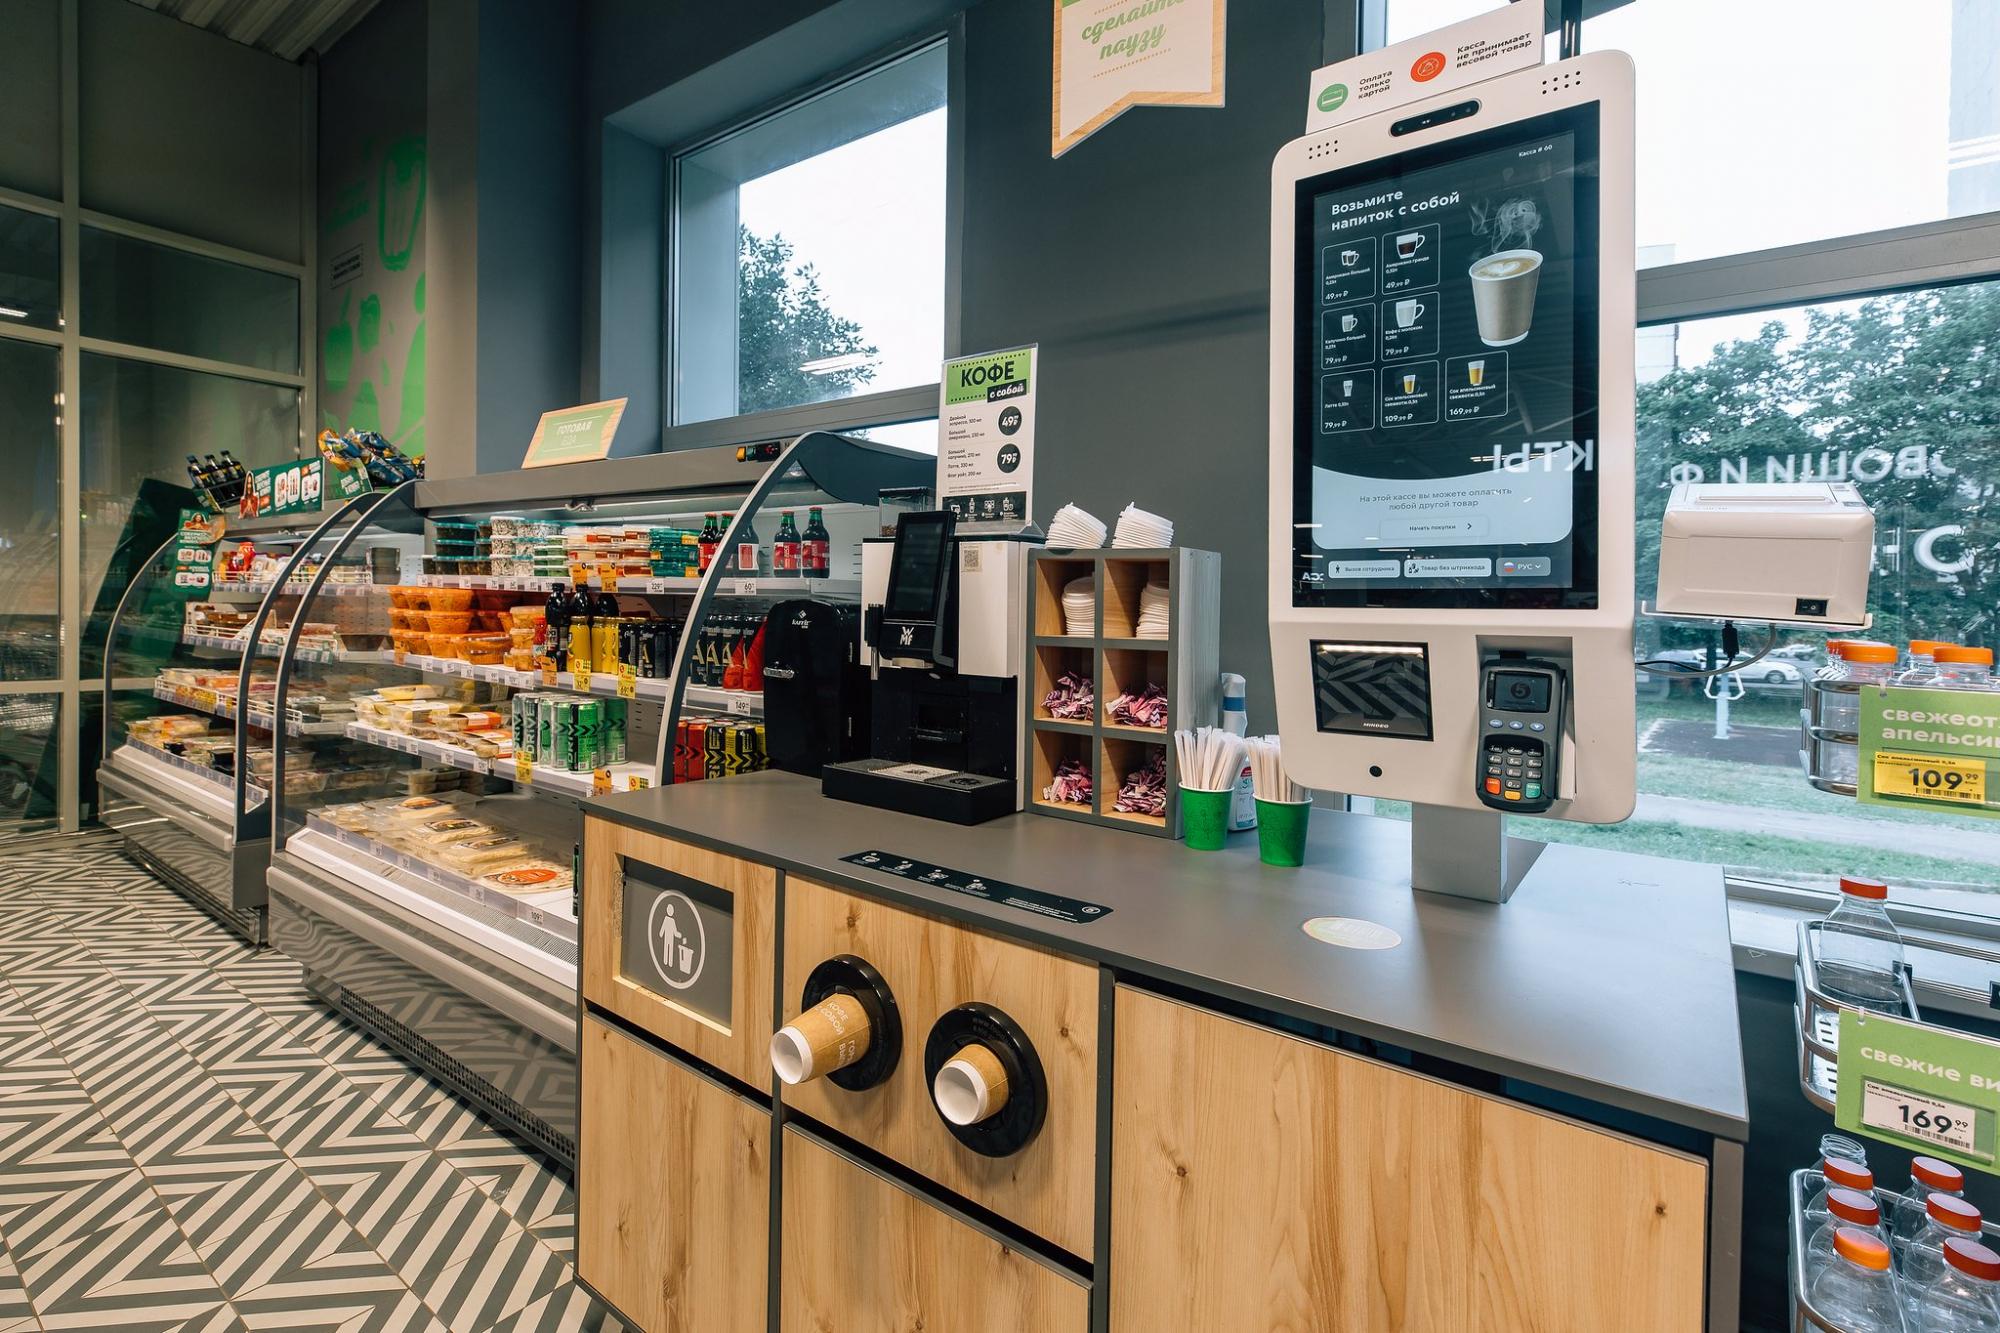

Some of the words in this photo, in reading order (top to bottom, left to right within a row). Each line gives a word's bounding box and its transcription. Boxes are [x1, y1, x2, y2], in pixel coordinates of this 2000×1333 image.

[1100, 23, 1167, 60] паузу
[1456, 51, 1470, 61] не
[1471, 32, 1532, 58] принимает
[1457, 39, 1486, 54] Касса
[1456, 50, 1499, 68] весовой
[1501, 40, 1532, 57] товар
[1360, 70, 1393, 85] Оплата
[1358, 85, 1391, 100] картой
[1359, 78, 1391, 93] только
[1518, 149, 1537, 158] Касса
[1331, 189, 1404, 215] Возьмите
[1331, 207, 1395, 231] напиток
[1398, 206, 1406, 215] с
[1410, 191, 1460, 214] собой
[961, 360, 1015, 388] КОФЕ
[996, 383, 1024, 398] собой
[1385, 414, 1406, 423] 109,99
[1450, 408, 1472, 416] 169,99
[1001, 416, 1014, 427] 49
[1001, 453, 1012, 464] 79
[1372, 494, 1391, 502] этой
[1393, 493, 1416, 501] кассе
[1432, 490, 1467, 499] можете
[1389, 502, 1417, 511] любой
[1418, 500, 1450, 510] другой
[1453, 500, 1479, 508] товар
[1431, 523, 1456, 532] покупки
[1517, 562, 1533, 571] РУС
[1882, 708, 2000, 729] свежеот
[525, 702, 536, 754] DRIVE
[1908, 767, 1963, 790] 109
[1860, 1047, 1961, 1082] свежие
[1898, 1104, 1952, 1134] 169
[1955, 1119, 1969, 1128] 99
